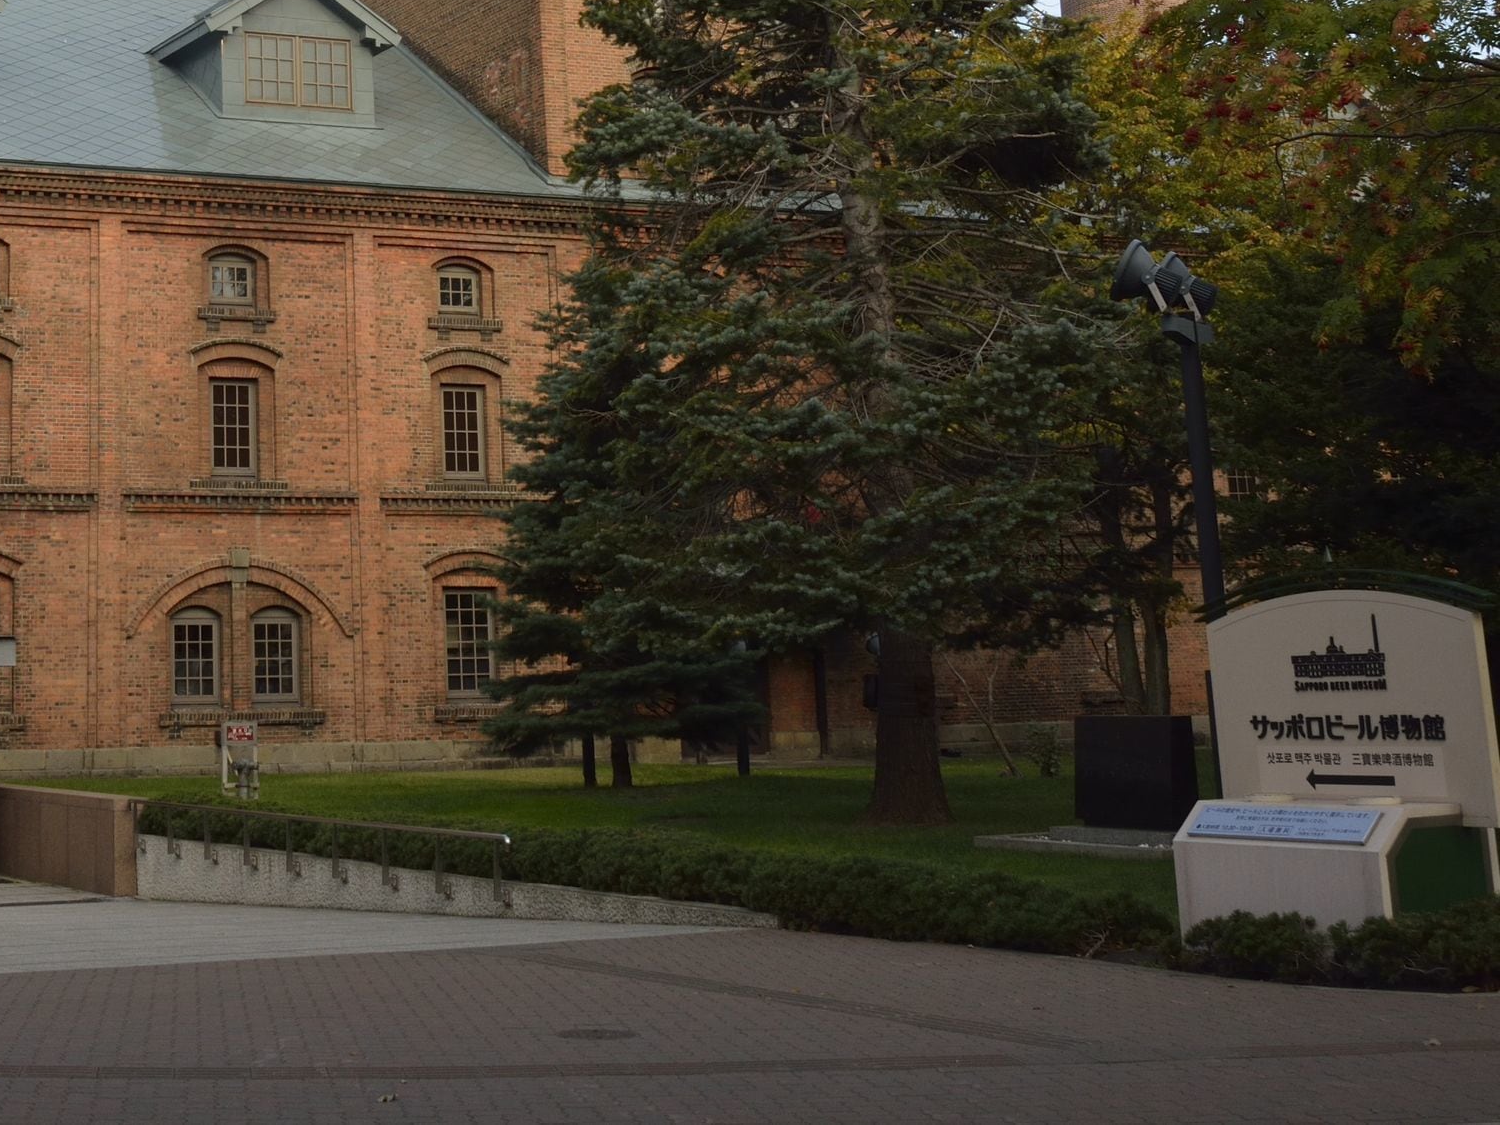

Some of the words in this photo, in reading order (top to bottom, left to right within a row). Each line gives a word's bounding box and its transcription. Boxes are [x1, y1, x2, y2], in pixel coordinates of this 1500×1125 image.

[1294, 680, 1329, 693] SAPPORO
[1330, 680, 1350, 692] BEER
[1351, 678, 1387, 691] MUSEUM
[1250, 713, 1446, 741] サッポロビール博物館
